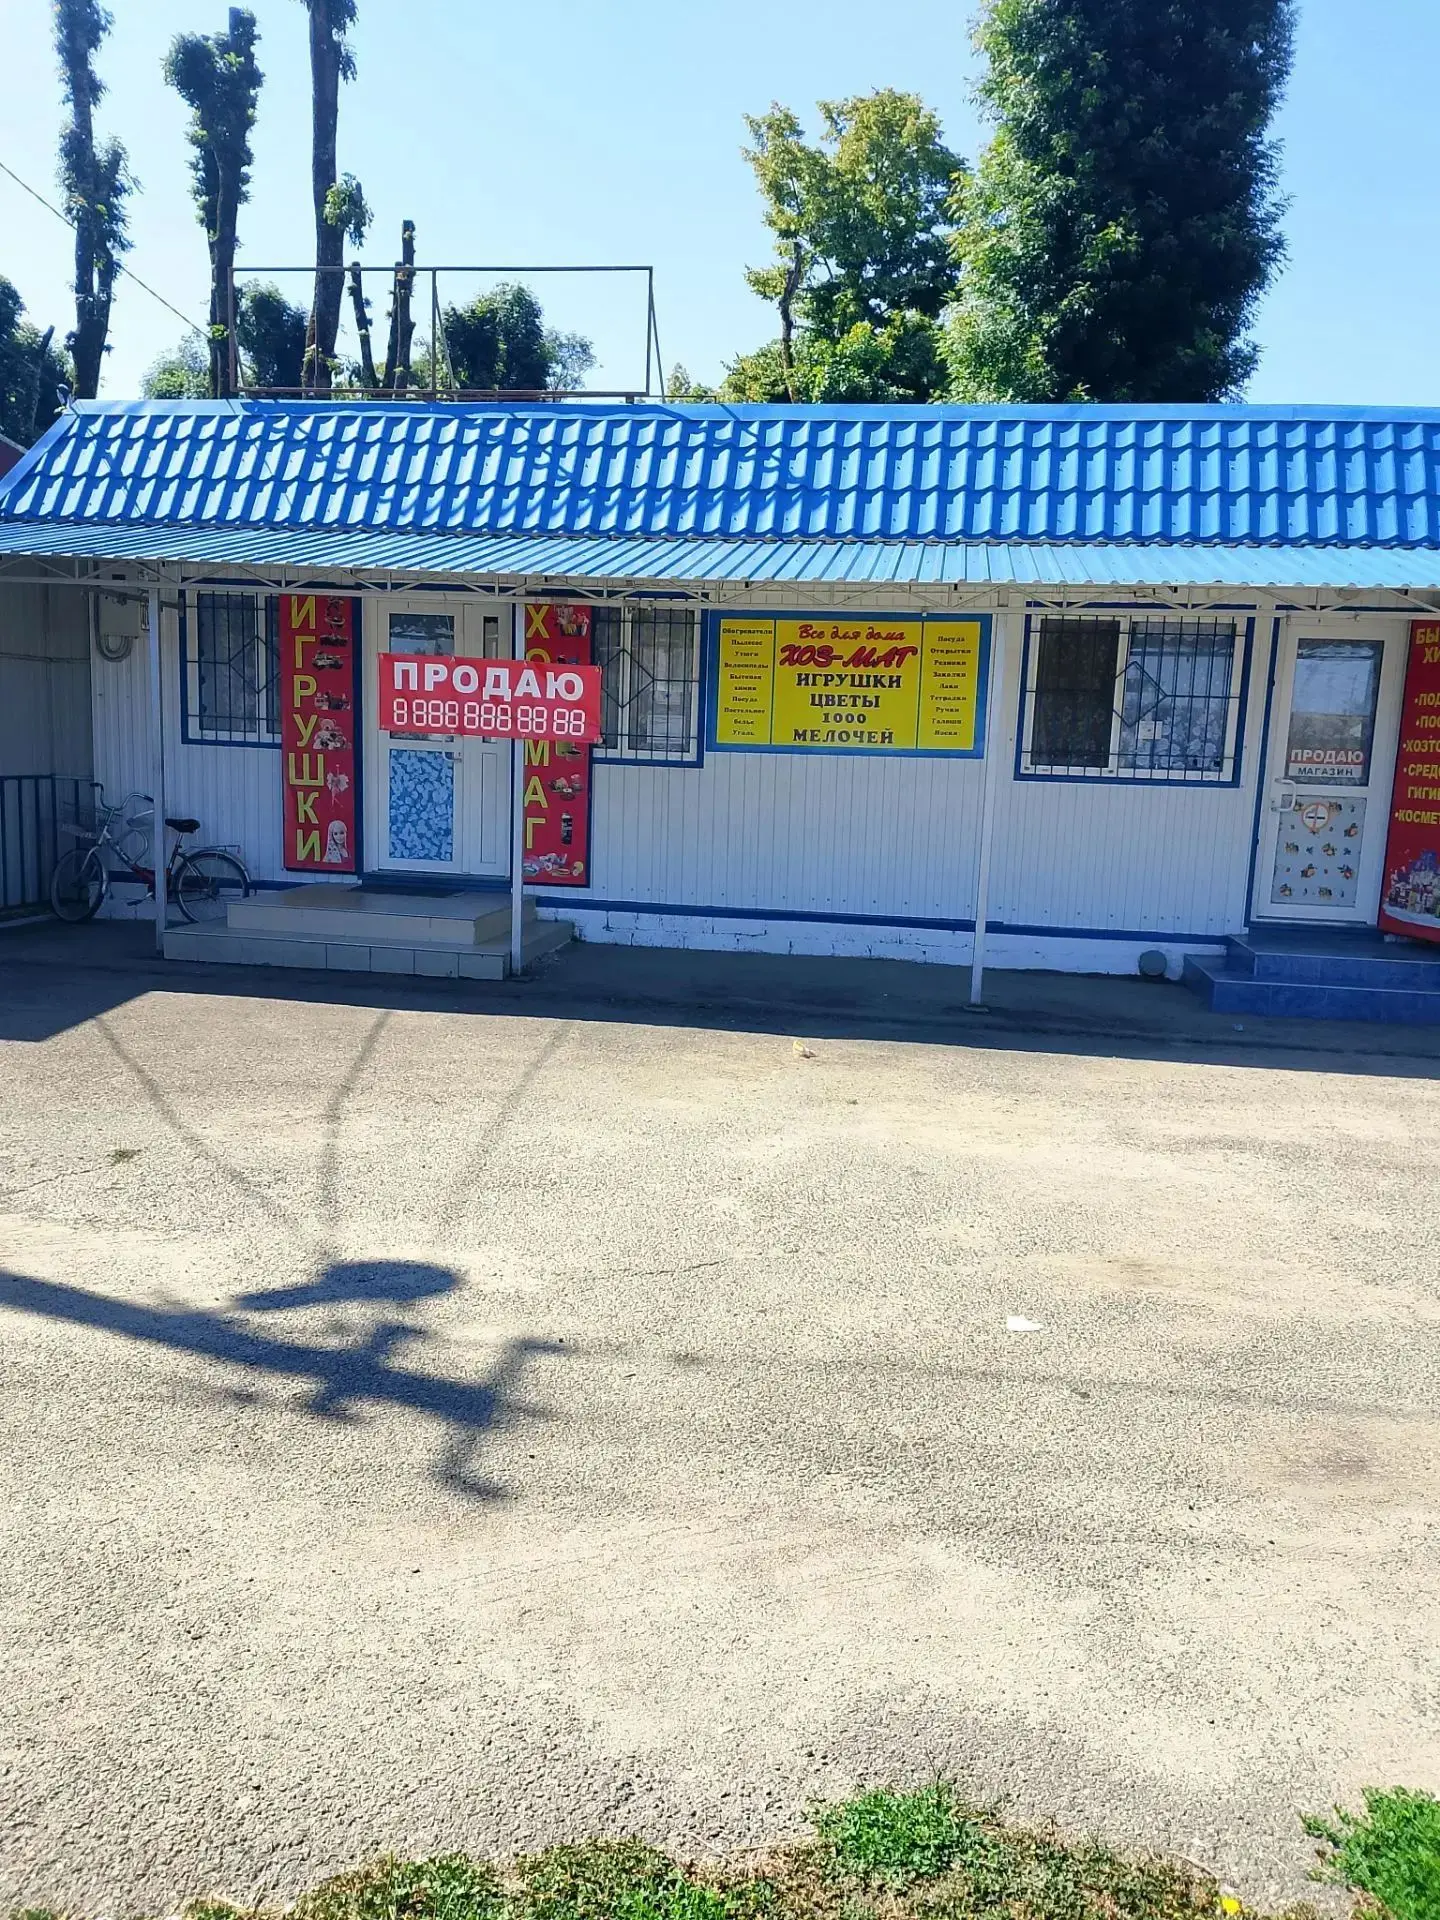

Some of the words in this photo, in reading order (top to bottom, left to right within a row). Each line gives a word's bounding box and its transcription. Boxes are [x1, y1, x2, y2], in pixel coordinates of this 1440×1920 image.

[798, 624, 825, 639] Все
[830, 626, 861, 640] для
[865, 626, 905, 640] дома
[930, 647, 972, 655] Открытки
[393, 661, 585, 702] ПРОДАЮ
[796, 672, 902, 689] ИГРУШКИ
[809, 693, 881, 708] ЦВЕТЫ
[393, 698, 408, 726] 8
[412, 699, 459, 729] 888
[463, 701, 512, 732] 888
[517, 705, 548, 734] 88
[552, 708, 586, 736] 88
[821, 712, 867, 724] 1000
[288, 595, 325, 862] ИГРУШКИ
[793, 728, 894, 744] МЕЛОЧЕЙ
[1290, 749, 1364, 764] ПРОДАЮ
[1297, 767, 1353, 776] МАГАЗИН
